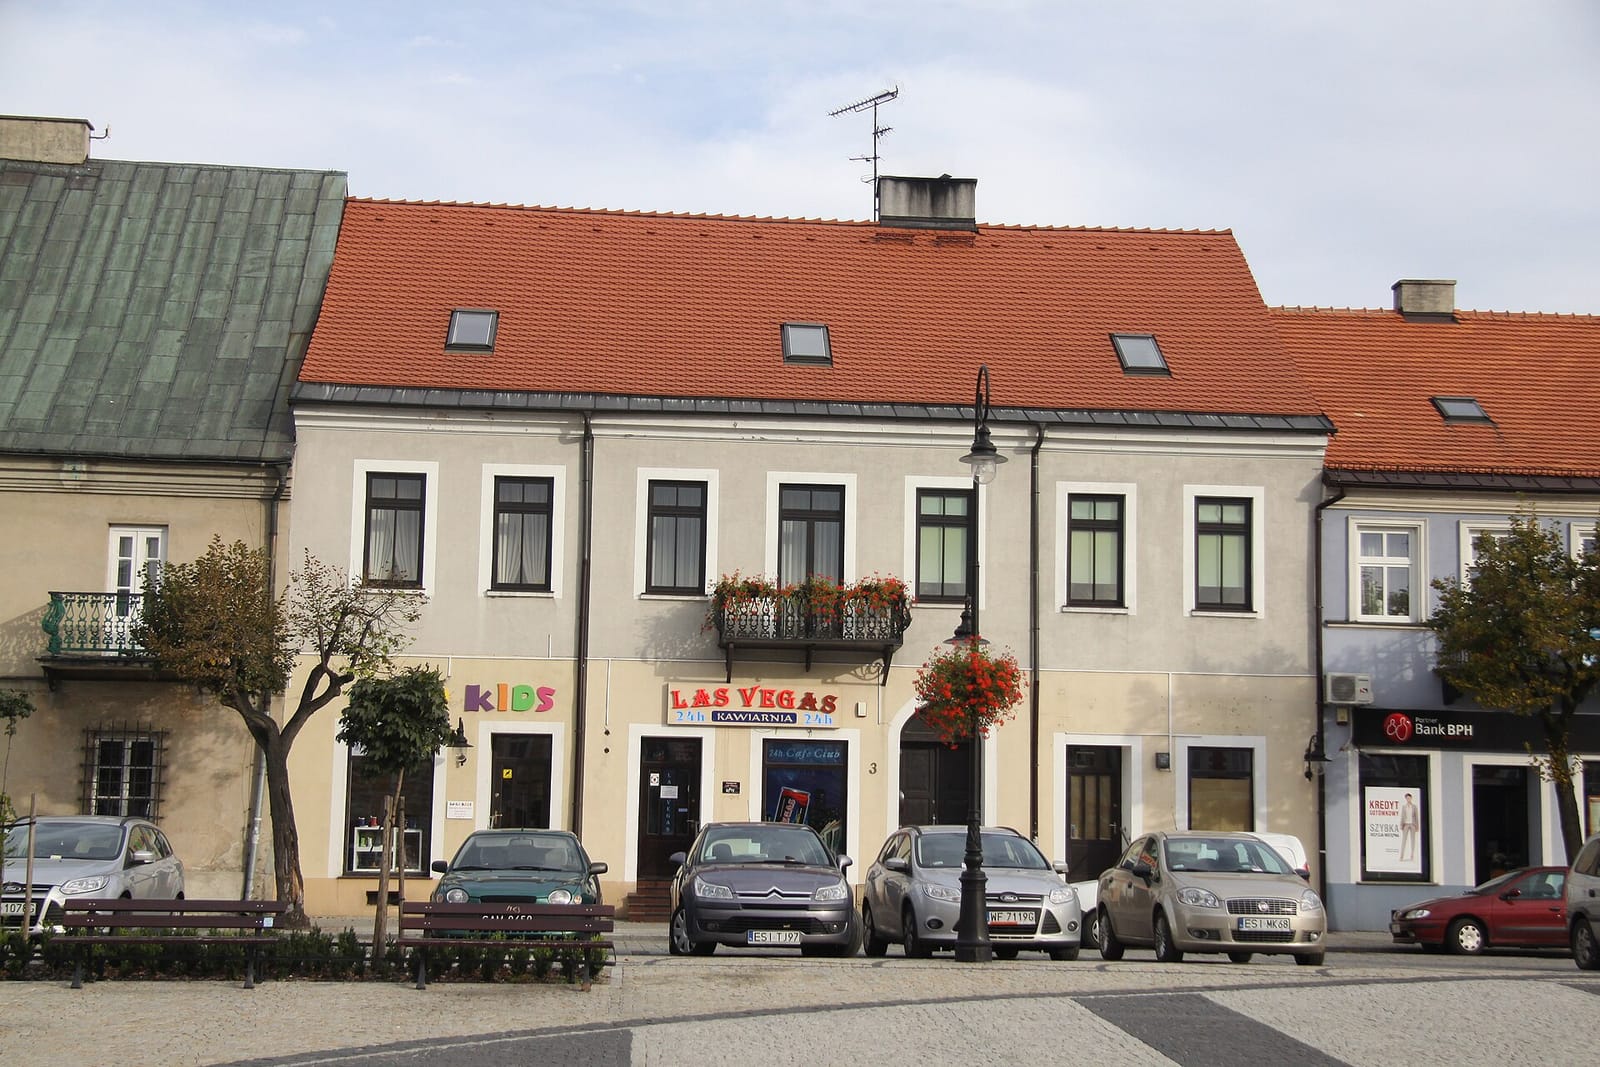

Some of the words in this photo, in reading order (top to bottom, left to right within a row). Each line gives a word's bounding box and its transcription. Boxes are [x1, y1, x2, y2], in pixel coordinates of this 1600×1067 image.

[464, 683, 556, 712] KIDS
[671, 687, 729, 709] LAS
[737, 685, 838, 714] VEGAS
[676, 711, 705, 722] 24h
[717, 712, 793, 722] KAWIARNIA
[804, 713, 832, 725] 24h
[1415, 723, 1446, 736] Bank
[1447, 724, 1473, 736] BPH
[868, 762, 878, 775] 3
[1369, 800, 1399, 810] KREDYT
[1369, 823, 1399, 833] SZYBKA
[1007, 912, 1034, 922] 7119G
[777, 932, 799, 942] TJ97
